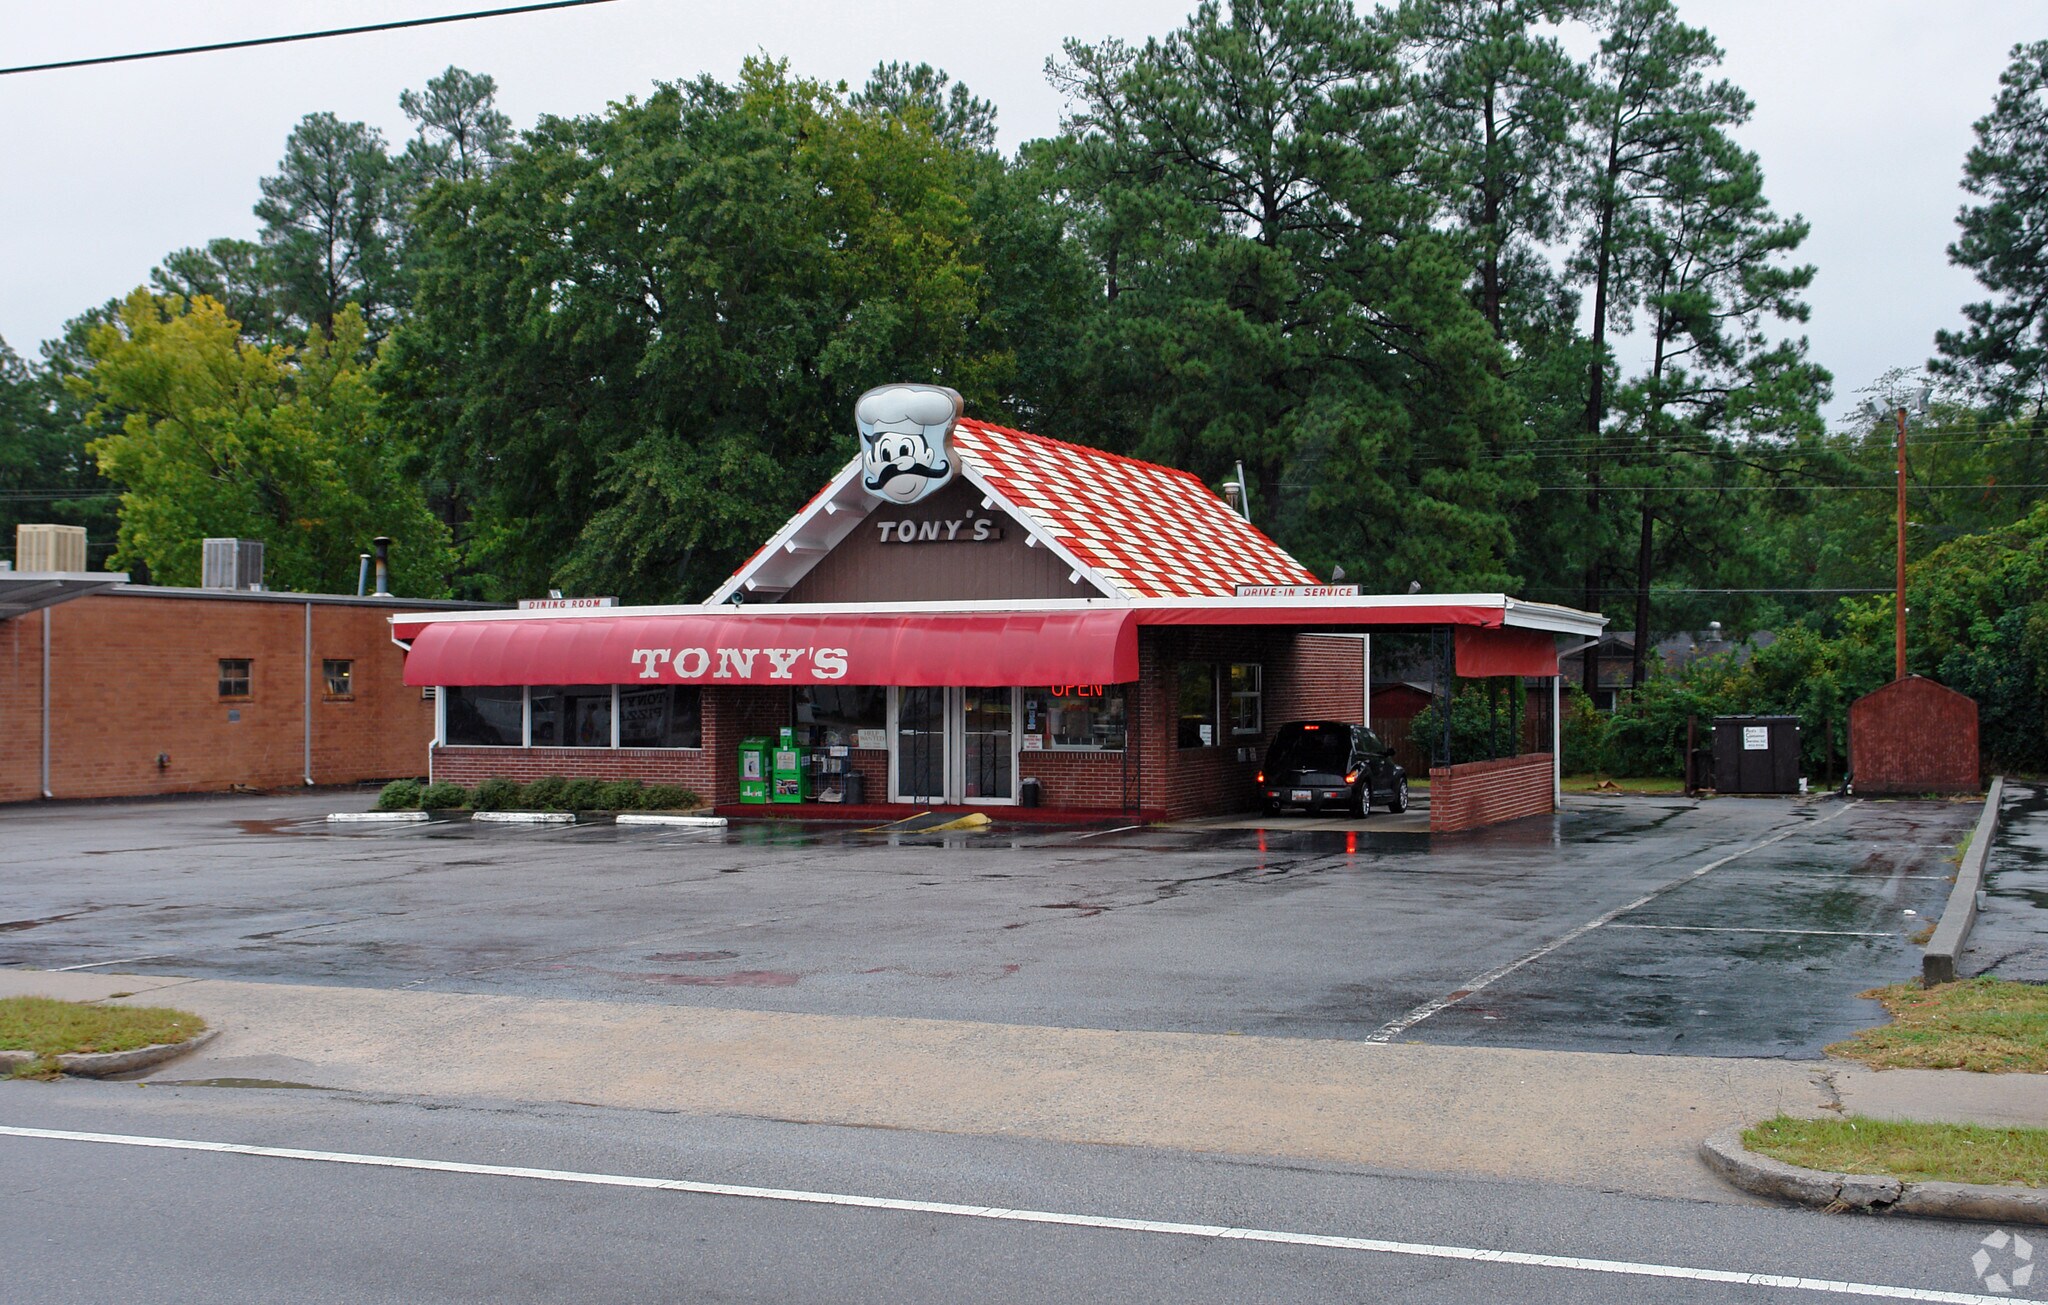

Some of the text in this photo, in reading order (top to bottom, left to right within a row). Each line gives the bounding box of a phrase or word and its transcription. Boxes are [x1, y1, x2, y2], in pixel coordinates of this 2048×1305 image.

[877, 509, 993, 542] TONY'S
[1243, 587, 1353, 596] DRIVE-IN SERVICE
[528, 599, 601, 610] DINING ROOM
[631, 646, 849, 680] TONY'S
